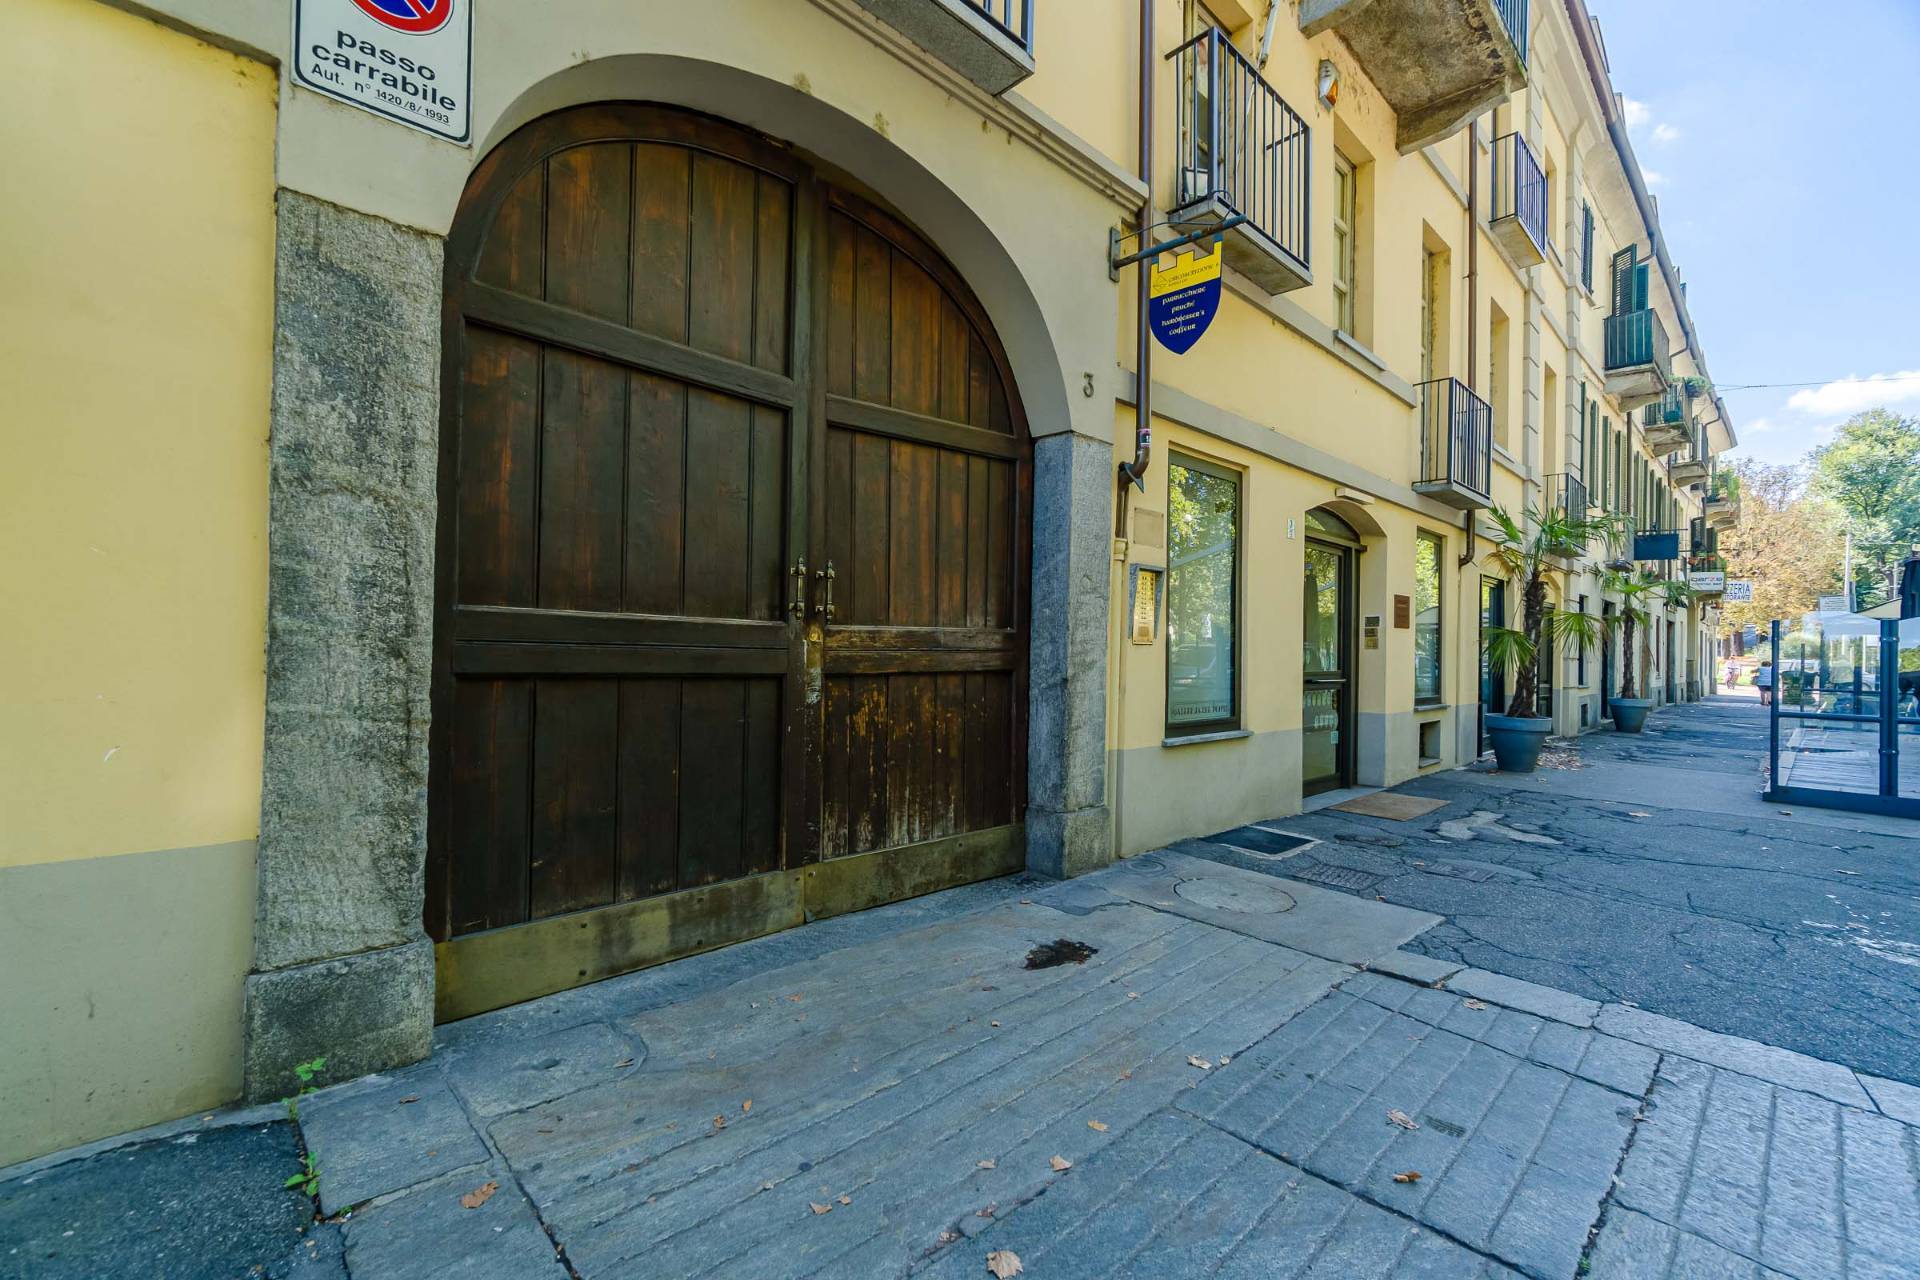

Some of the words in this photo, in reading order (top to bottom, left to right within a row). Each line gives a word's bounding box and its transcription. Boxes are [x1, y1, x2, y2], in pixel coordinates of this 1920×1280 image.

[337, 30, 436, 81] passo
[311, 63, 344, 86] Aut.
[311, 44, 456, 111] carrabile
[1083, 371, 1094, 398] 3
[1726, 583, 1750, 595] ZZERIA
